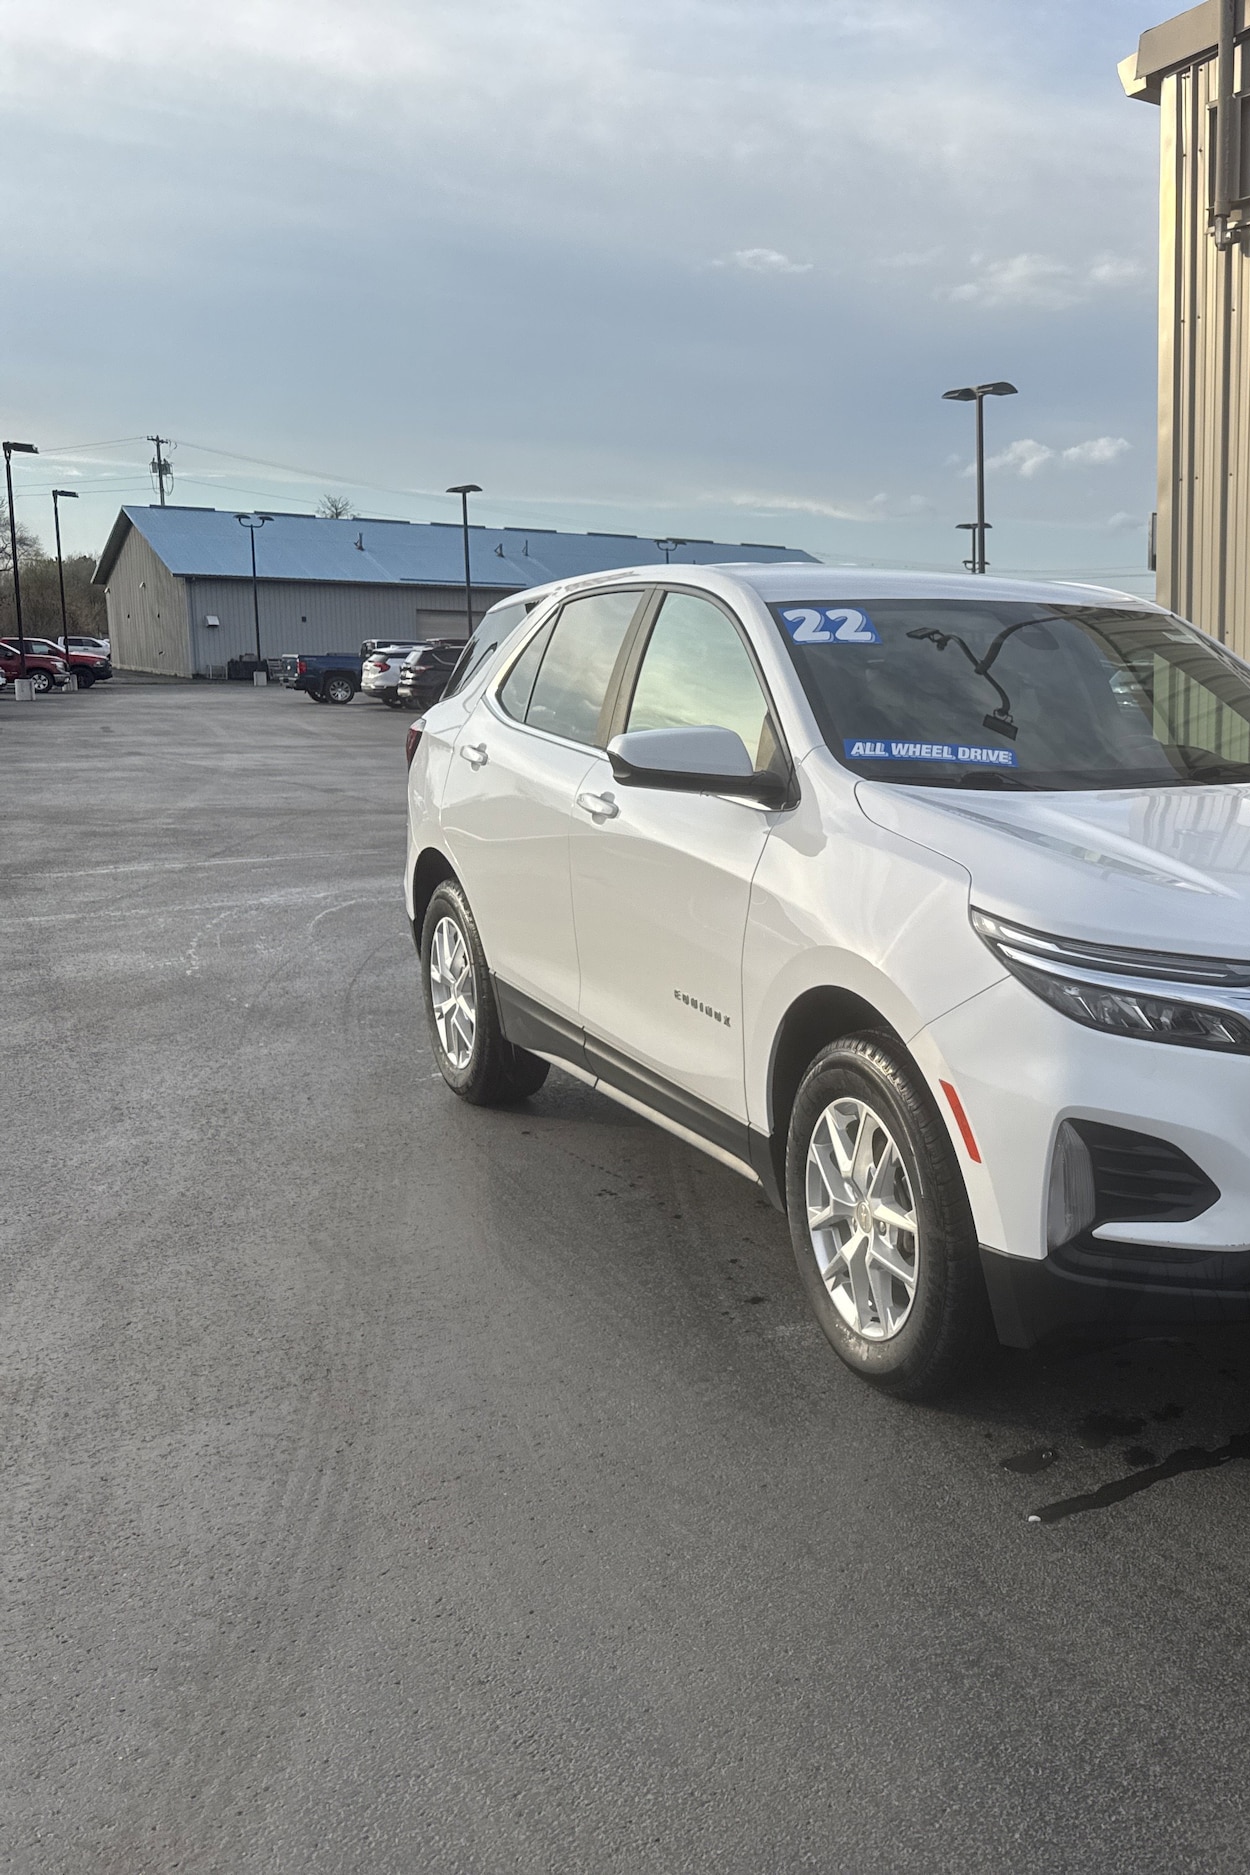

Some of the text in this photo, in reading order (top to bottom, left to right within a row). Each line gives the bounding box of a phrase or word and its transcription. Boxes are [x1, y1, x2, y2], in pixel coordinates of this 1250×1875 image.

[783, 608, 875, 643] 22
[851, 741, 1012, 764] ALL WHEEL DRIVE
